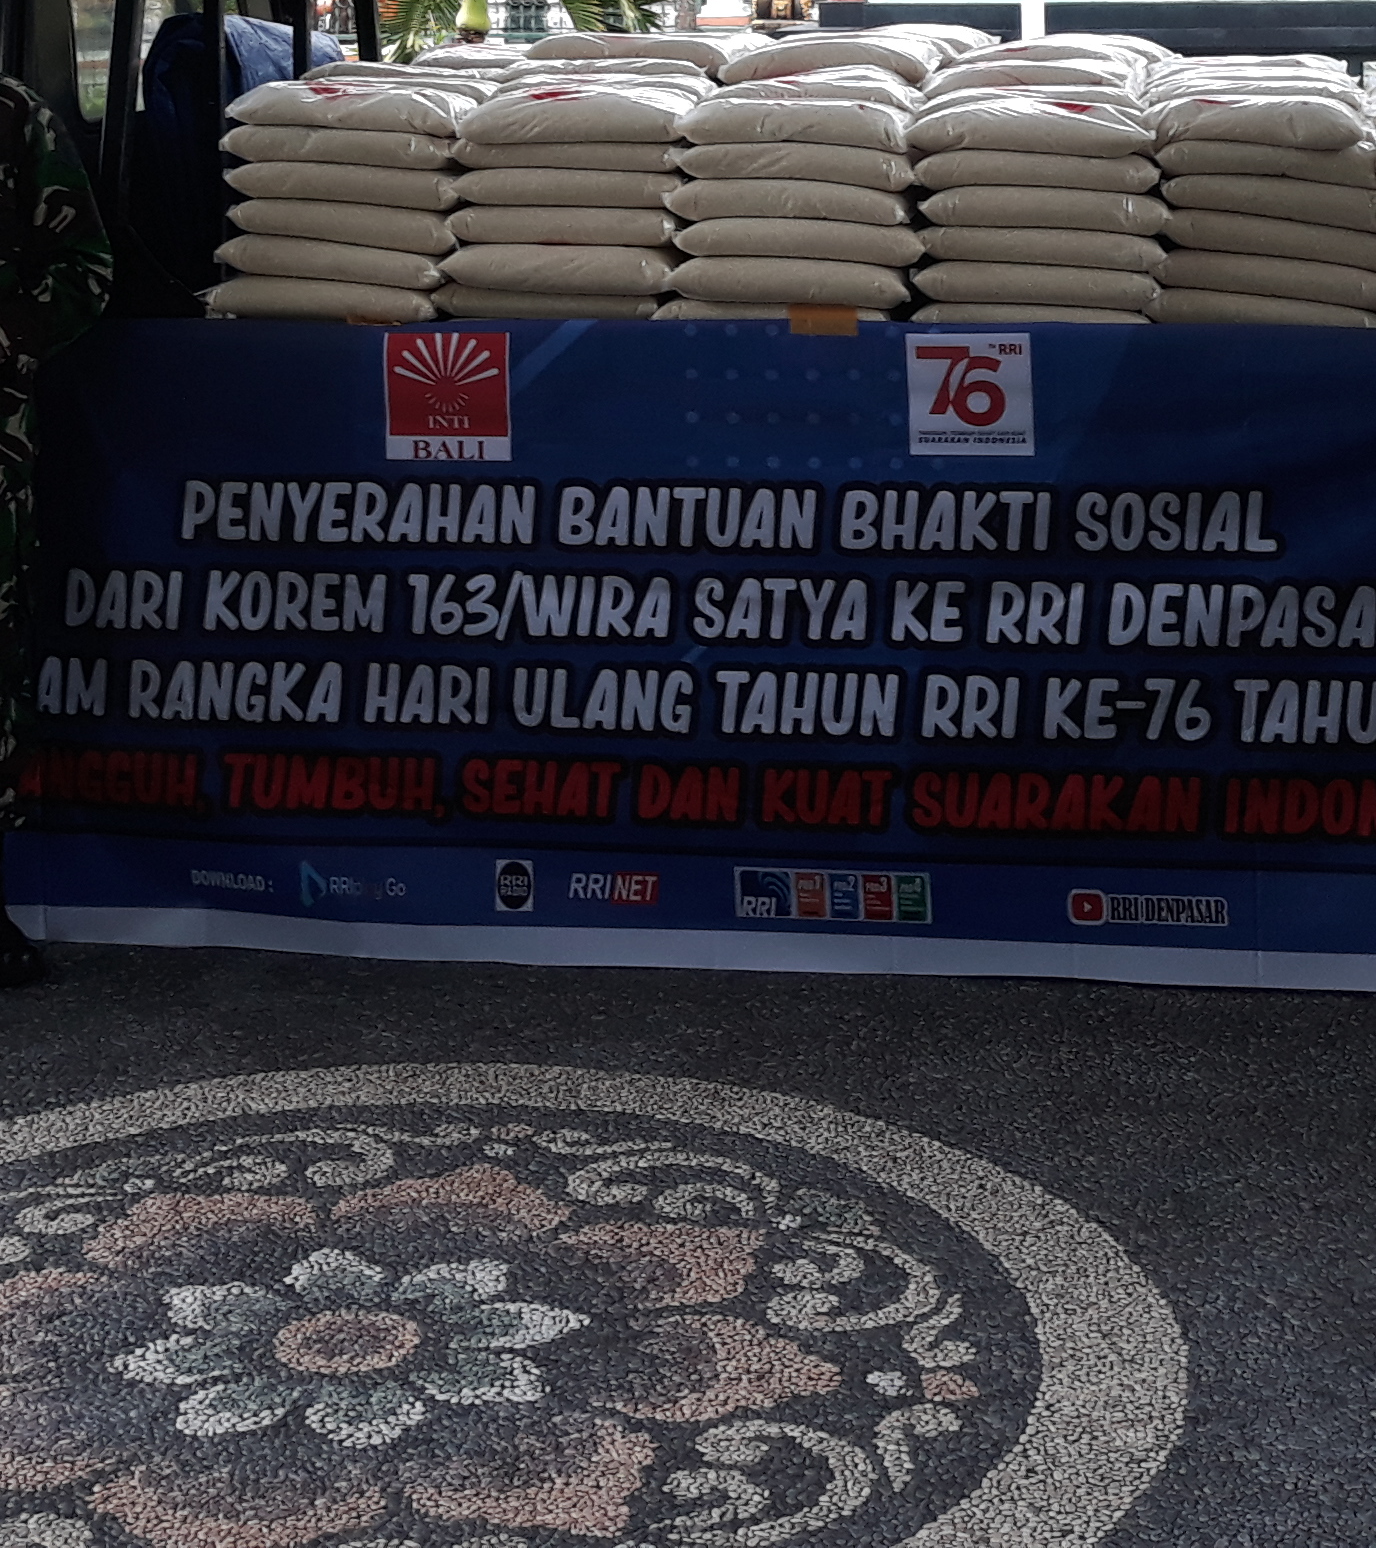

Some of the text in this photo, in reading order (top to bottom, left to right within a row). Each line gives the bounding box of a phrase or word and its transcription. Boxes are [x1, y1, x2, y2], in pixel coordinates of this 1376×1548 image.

[998, 344, 1022, 355] RRI
[915, 346, 1005, 426] 76
[428, 415, 470, 429] INTI
[412, 440, 485, 460] BALI
[179, 478, 1279, 554] PENYERAHAN BANTUAN BHAKTI SOSIAL
[63, 567, 184, 631] DARI
[203, 568, 388, 633] KOREM
[407, 569, 673, 642] 163/WIRA
[691, 576, 869, 642] SATYA
[890, 579, 967, 643] KE
[986, 581, 1087, 646] RRI
[127, 658, 343, 724] RANGKA
[362, 659, 492, 726] HARI
[512, 666, 694, 735] ULANG
[714, 669, 900, 738] TAHUN
[919, 673, 1022, 740] RRI
[1042, 675, 1214, 743] KE-76
[16, 746, 208, 813] ANGGUH,
[222, 752, 446, 819] TUMBUH,
[461, 756, 624, 819] SEHAT
[636, 763, 742, 823] DAN
[761, 767, 893, 827] KUAT
[911, 770, 1203, 834] SUARAKAN
[499, 875, 529, 887] RRI
[743, 896, 777, 917] RRI
[1110, 897, 1226, 924] RRI DENPASAR
